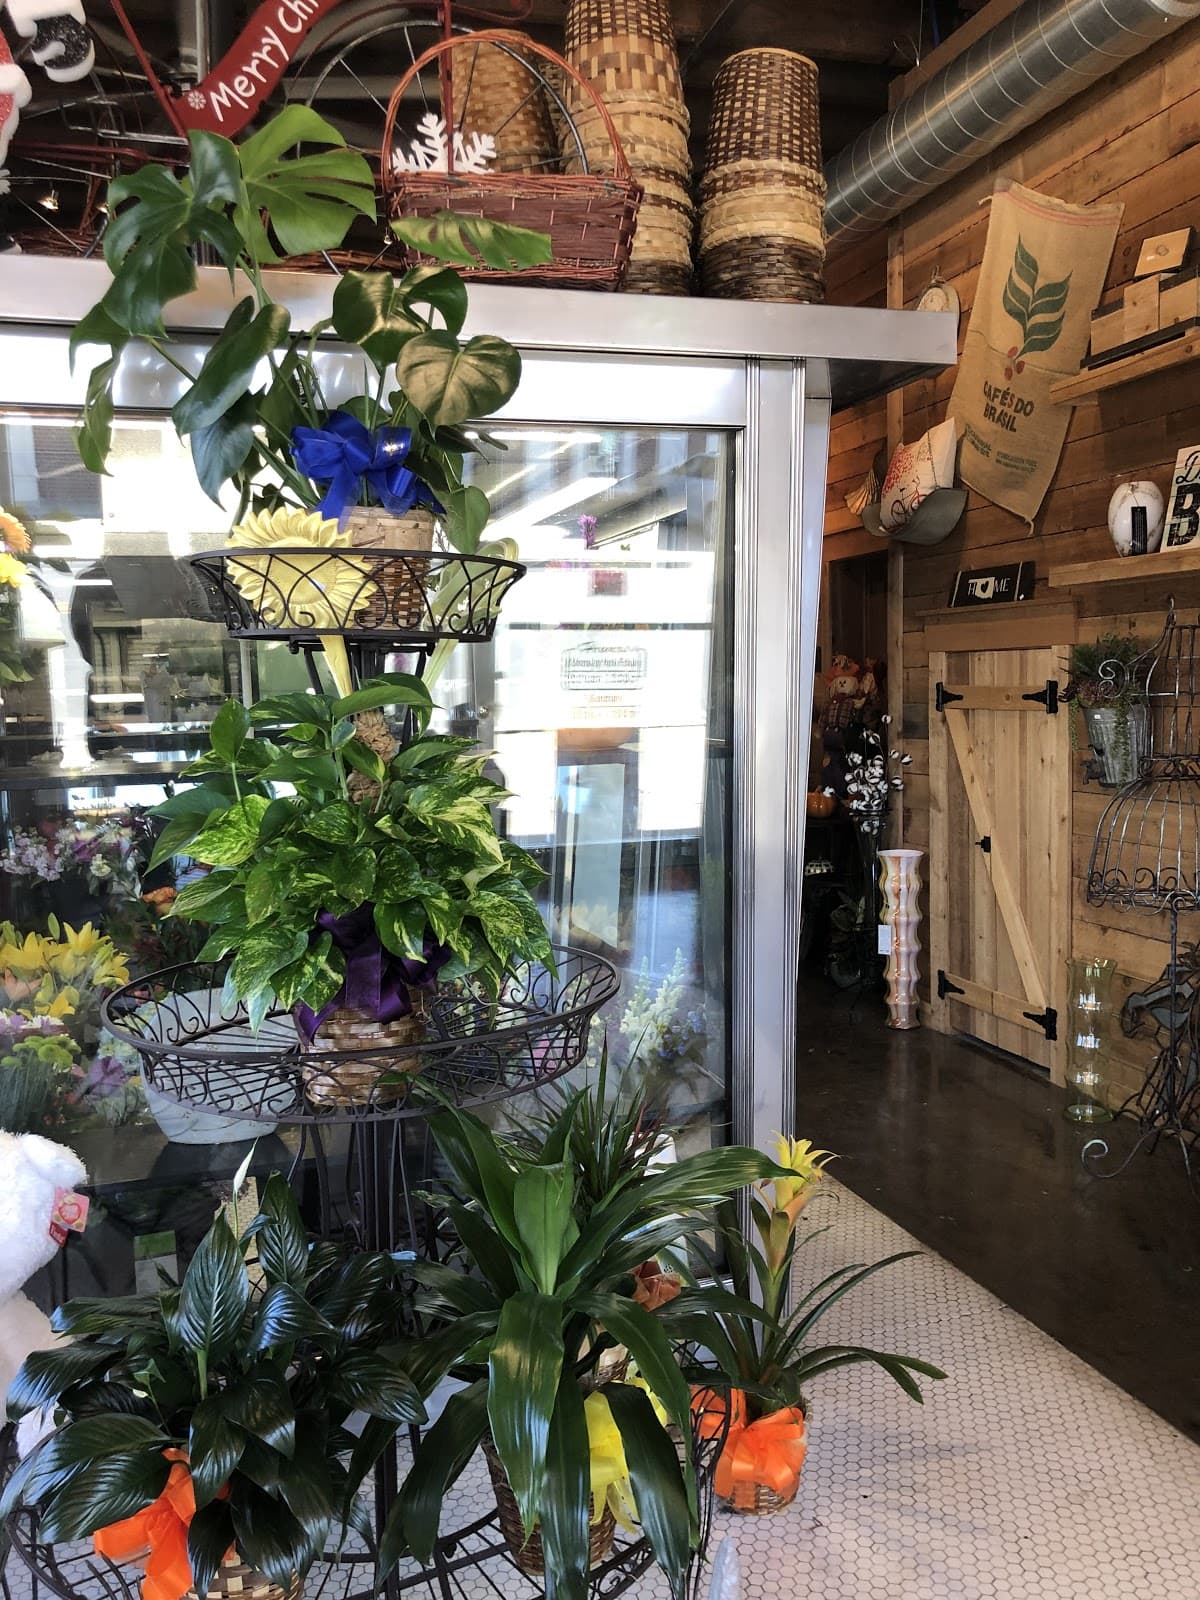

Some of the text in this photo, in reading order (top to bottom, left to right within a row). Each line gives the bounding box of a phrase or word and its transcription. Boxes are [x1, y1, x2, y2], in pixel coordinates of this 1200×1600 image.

[210, 0, 319, 122] Merry Ch
[983, 381, 1035, 417] CAFÉS DO
[983, 402, 1017, 433] BRASIL
